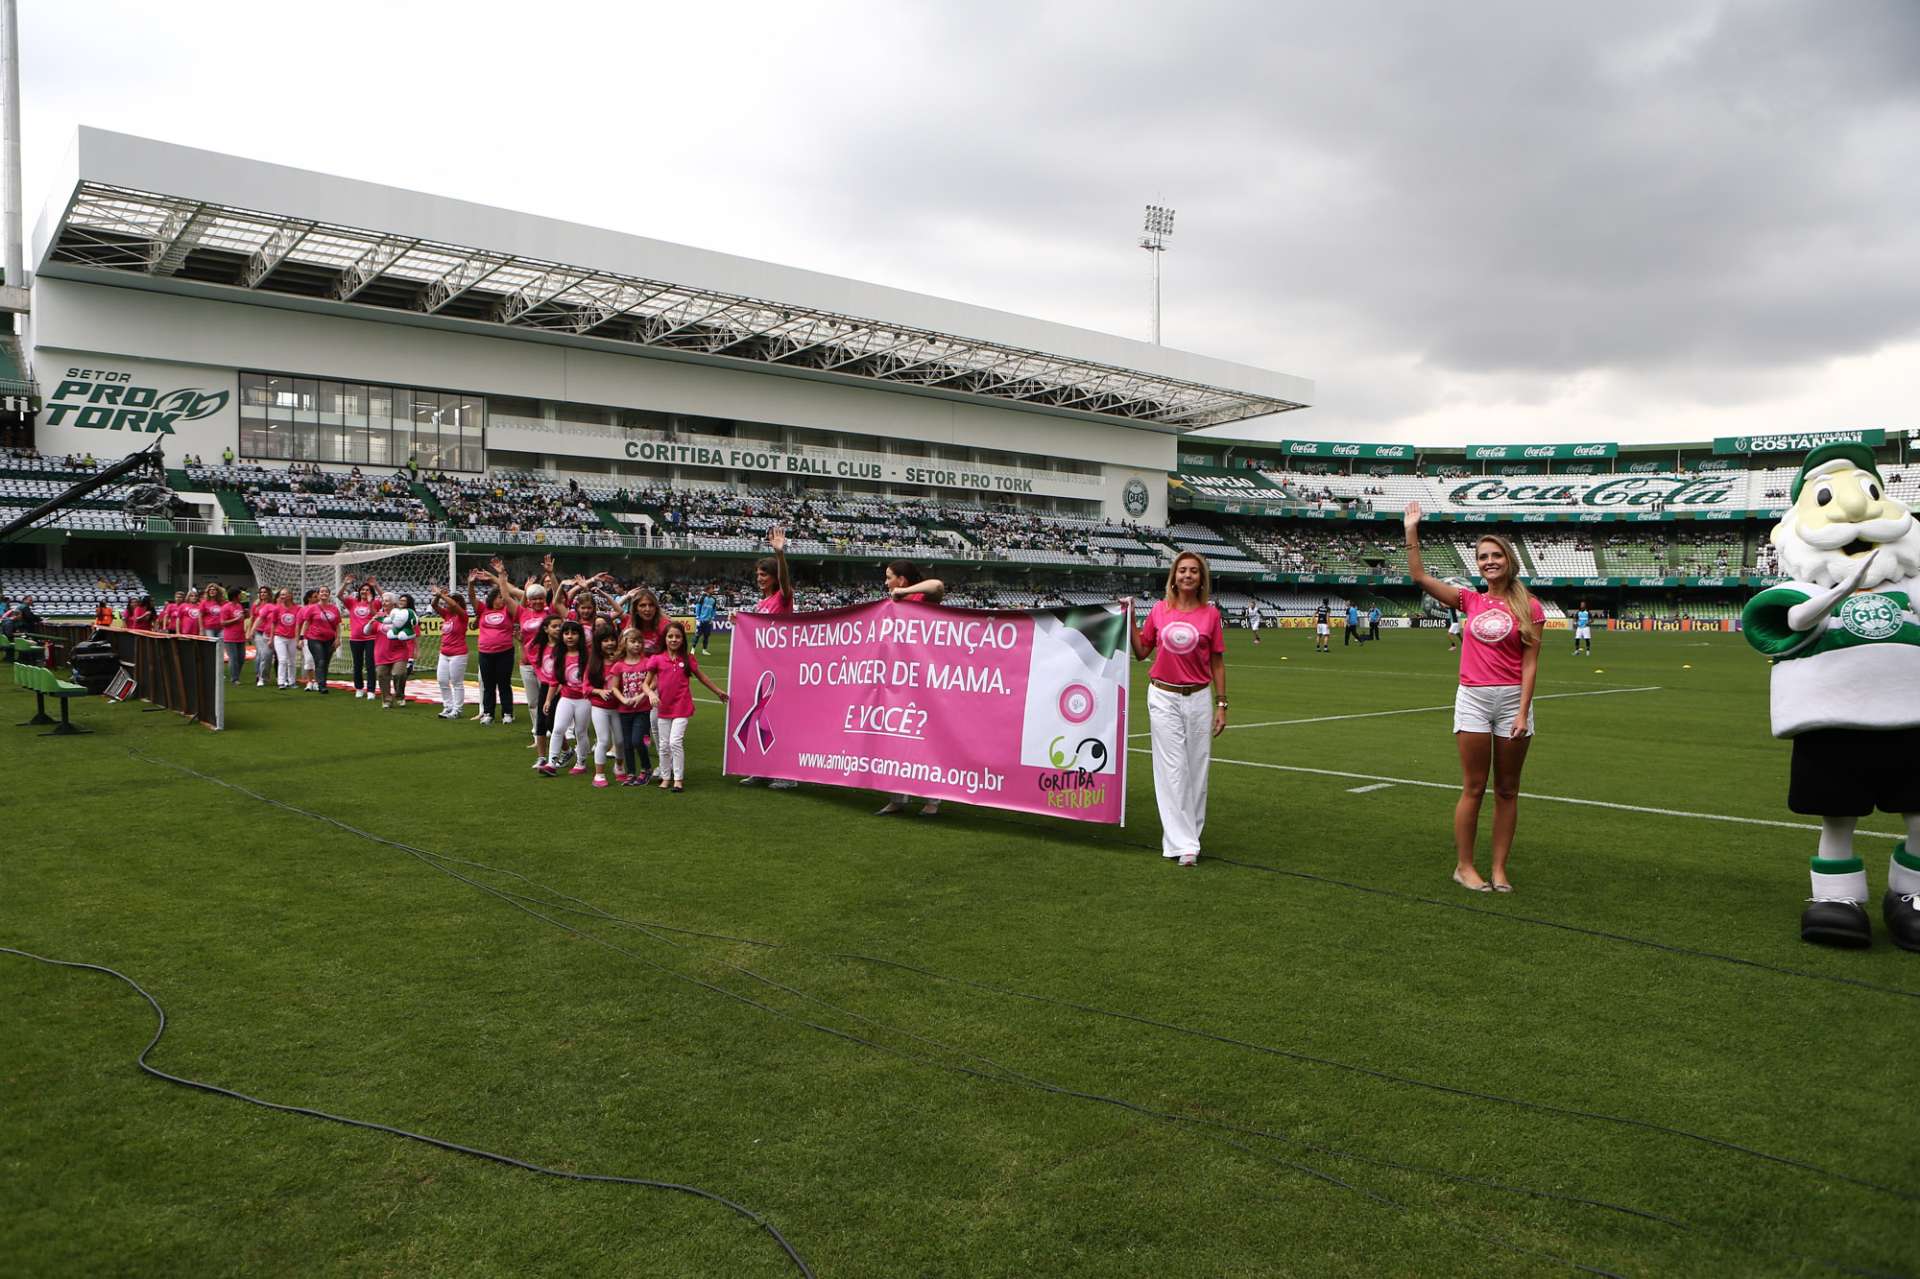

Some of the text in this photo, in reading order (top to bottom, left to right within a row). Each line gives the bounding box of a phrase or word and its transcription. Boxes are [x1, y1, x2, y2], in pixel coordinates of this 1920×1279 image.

[66, 367, 131, 383] SETOR
[51, 380, 158, 408] PRO
[46, 403, 176, 434] TORK
[625, 441, 724, 466] CORITIBA
[730, 450, 781, 470] FOOT
[786, 455, 832, 474] BALL
[837, 460, 882, 479] CLUB
[905, 467, 956, 486] SETOR
[961, 473, 991, 489] PRO
[994, 476, 1033, 492] TORK
[1180, 474, 1256, 488] CAMPEÃO
[1195, 486, 1287, 499] BRASILEIRO
[1855, 606, 1890, 622] CFC
[1420, 619, 1447, 629] IGUAIS
[1616, 619, 1641, 630] Itaú
[1653, 619, 1680, 631] Itaú
[1691, 619, 1719, 632] Itaú
[755, 616, 1018, 654] NÓS FAZEMOS A PREVENÇÃO
[799, 655, 1011, 695] DO CÂNCER DE MAMA.
[844, 701, 928, 735] E VOCÊ?
